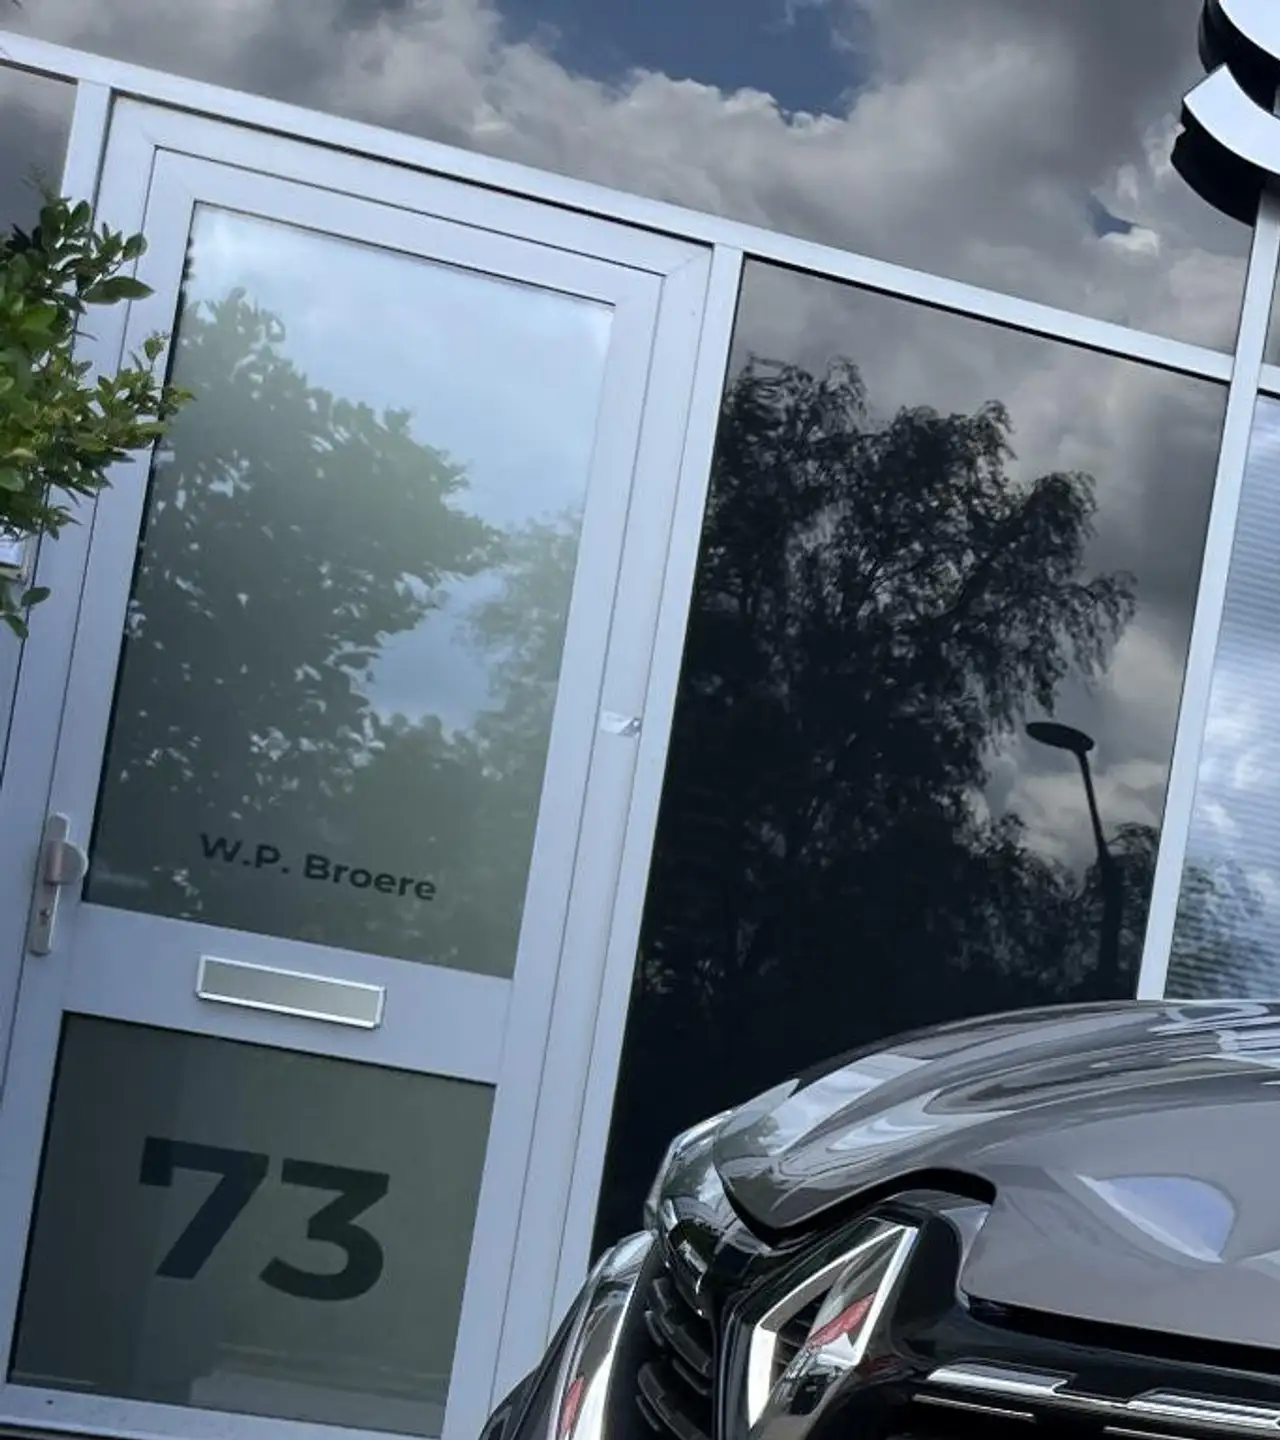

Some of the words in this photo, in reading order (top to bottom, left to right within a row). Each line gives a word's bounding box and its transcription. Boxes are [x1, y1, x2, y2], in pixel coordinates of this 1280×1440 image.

[200, 832, 290, 875] W.P.
[303, 853, 438, 901] Broere
[138, 1135, 391, 1302] 73
